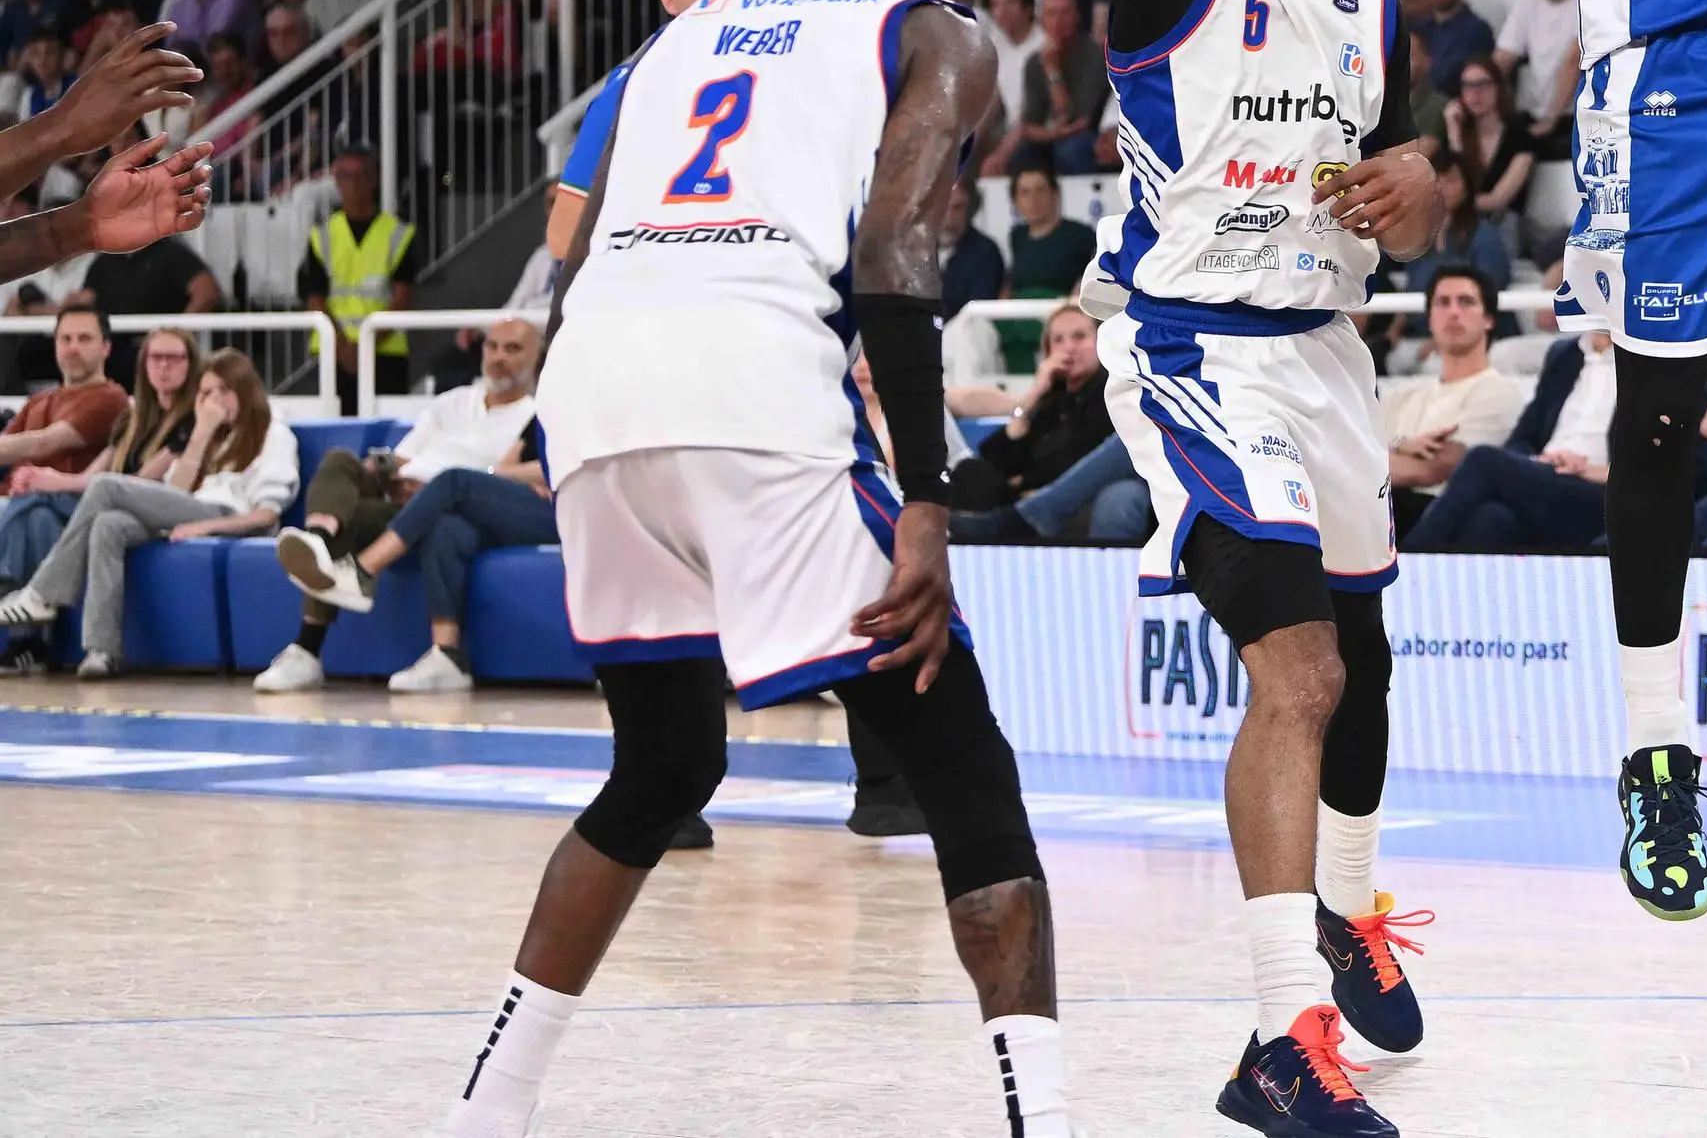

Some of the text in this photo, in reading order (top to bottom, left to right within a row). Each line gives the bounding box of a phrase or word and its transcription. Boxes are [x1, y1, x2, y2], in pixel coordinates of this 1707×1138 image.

[714, 20, 802, 55] WEBER
[661, 69, 757, 205] 2
[1141, 611, 1252, 718] PAST
[1391, 634, 1568, 666] Laboratorio past
